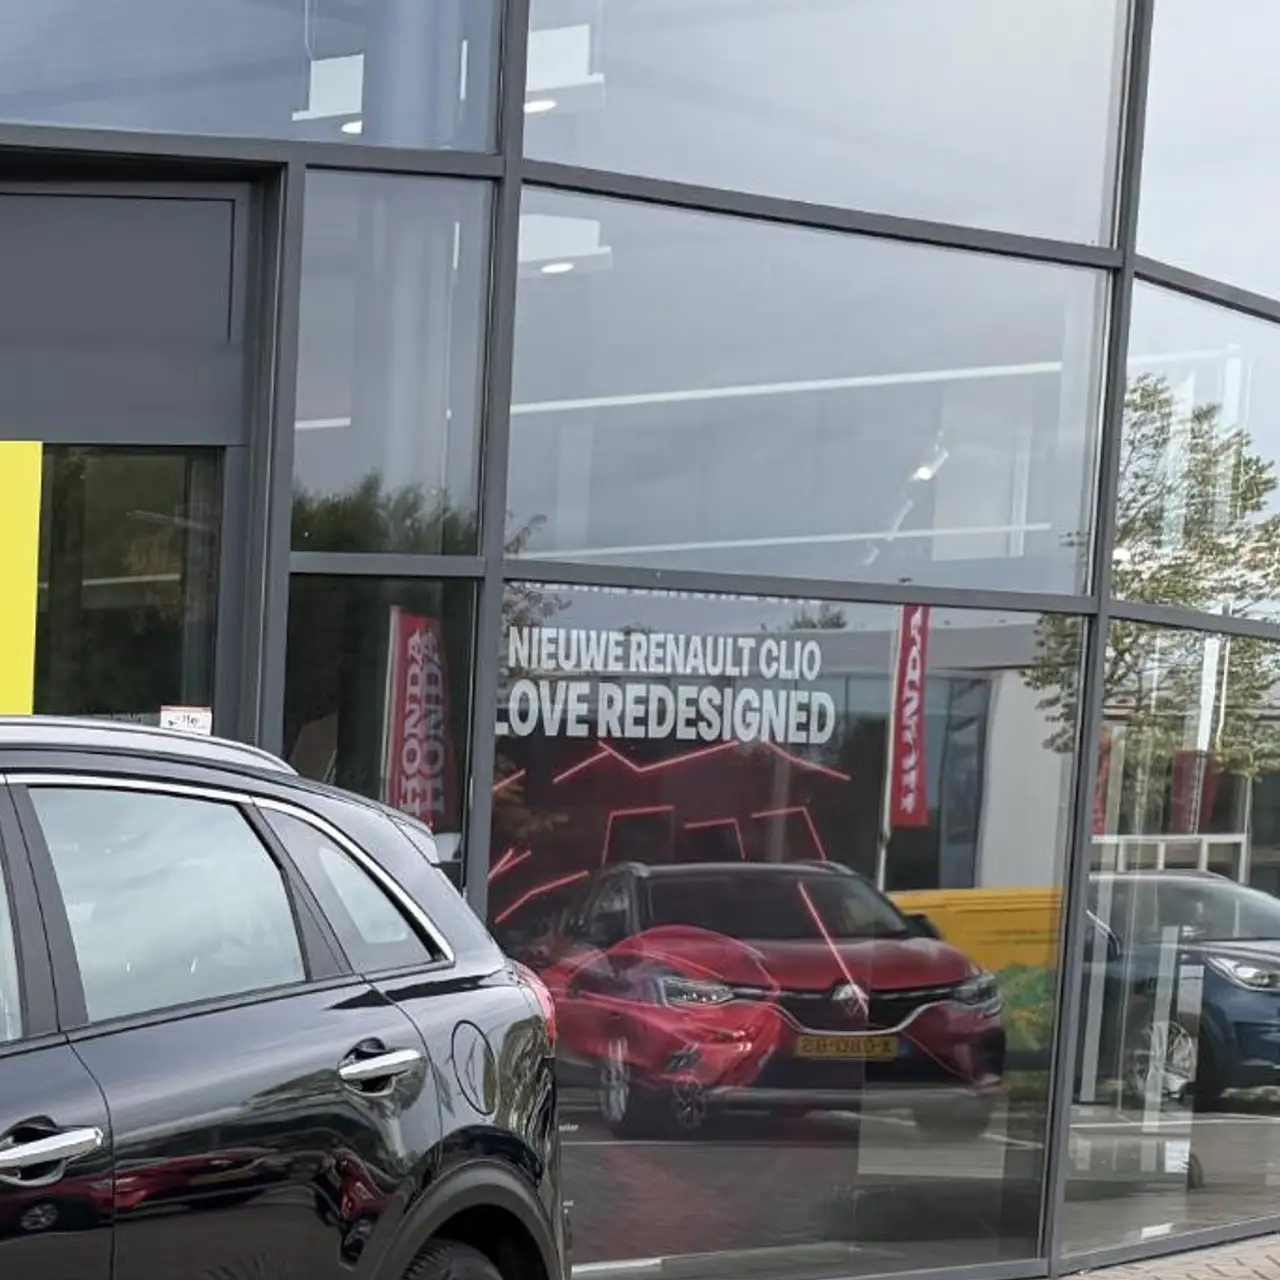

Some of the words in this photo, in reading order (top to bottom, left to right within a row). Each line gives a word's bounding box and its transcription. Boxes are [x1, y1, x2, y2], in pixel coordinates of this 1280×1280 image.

[508, 626, 625, 673] NIEUWE
[629, 631, 756, 677] RENAULT
[759, 639, 823, 681] CLIO
[597, 681, 836, 744] REDESIGNED
